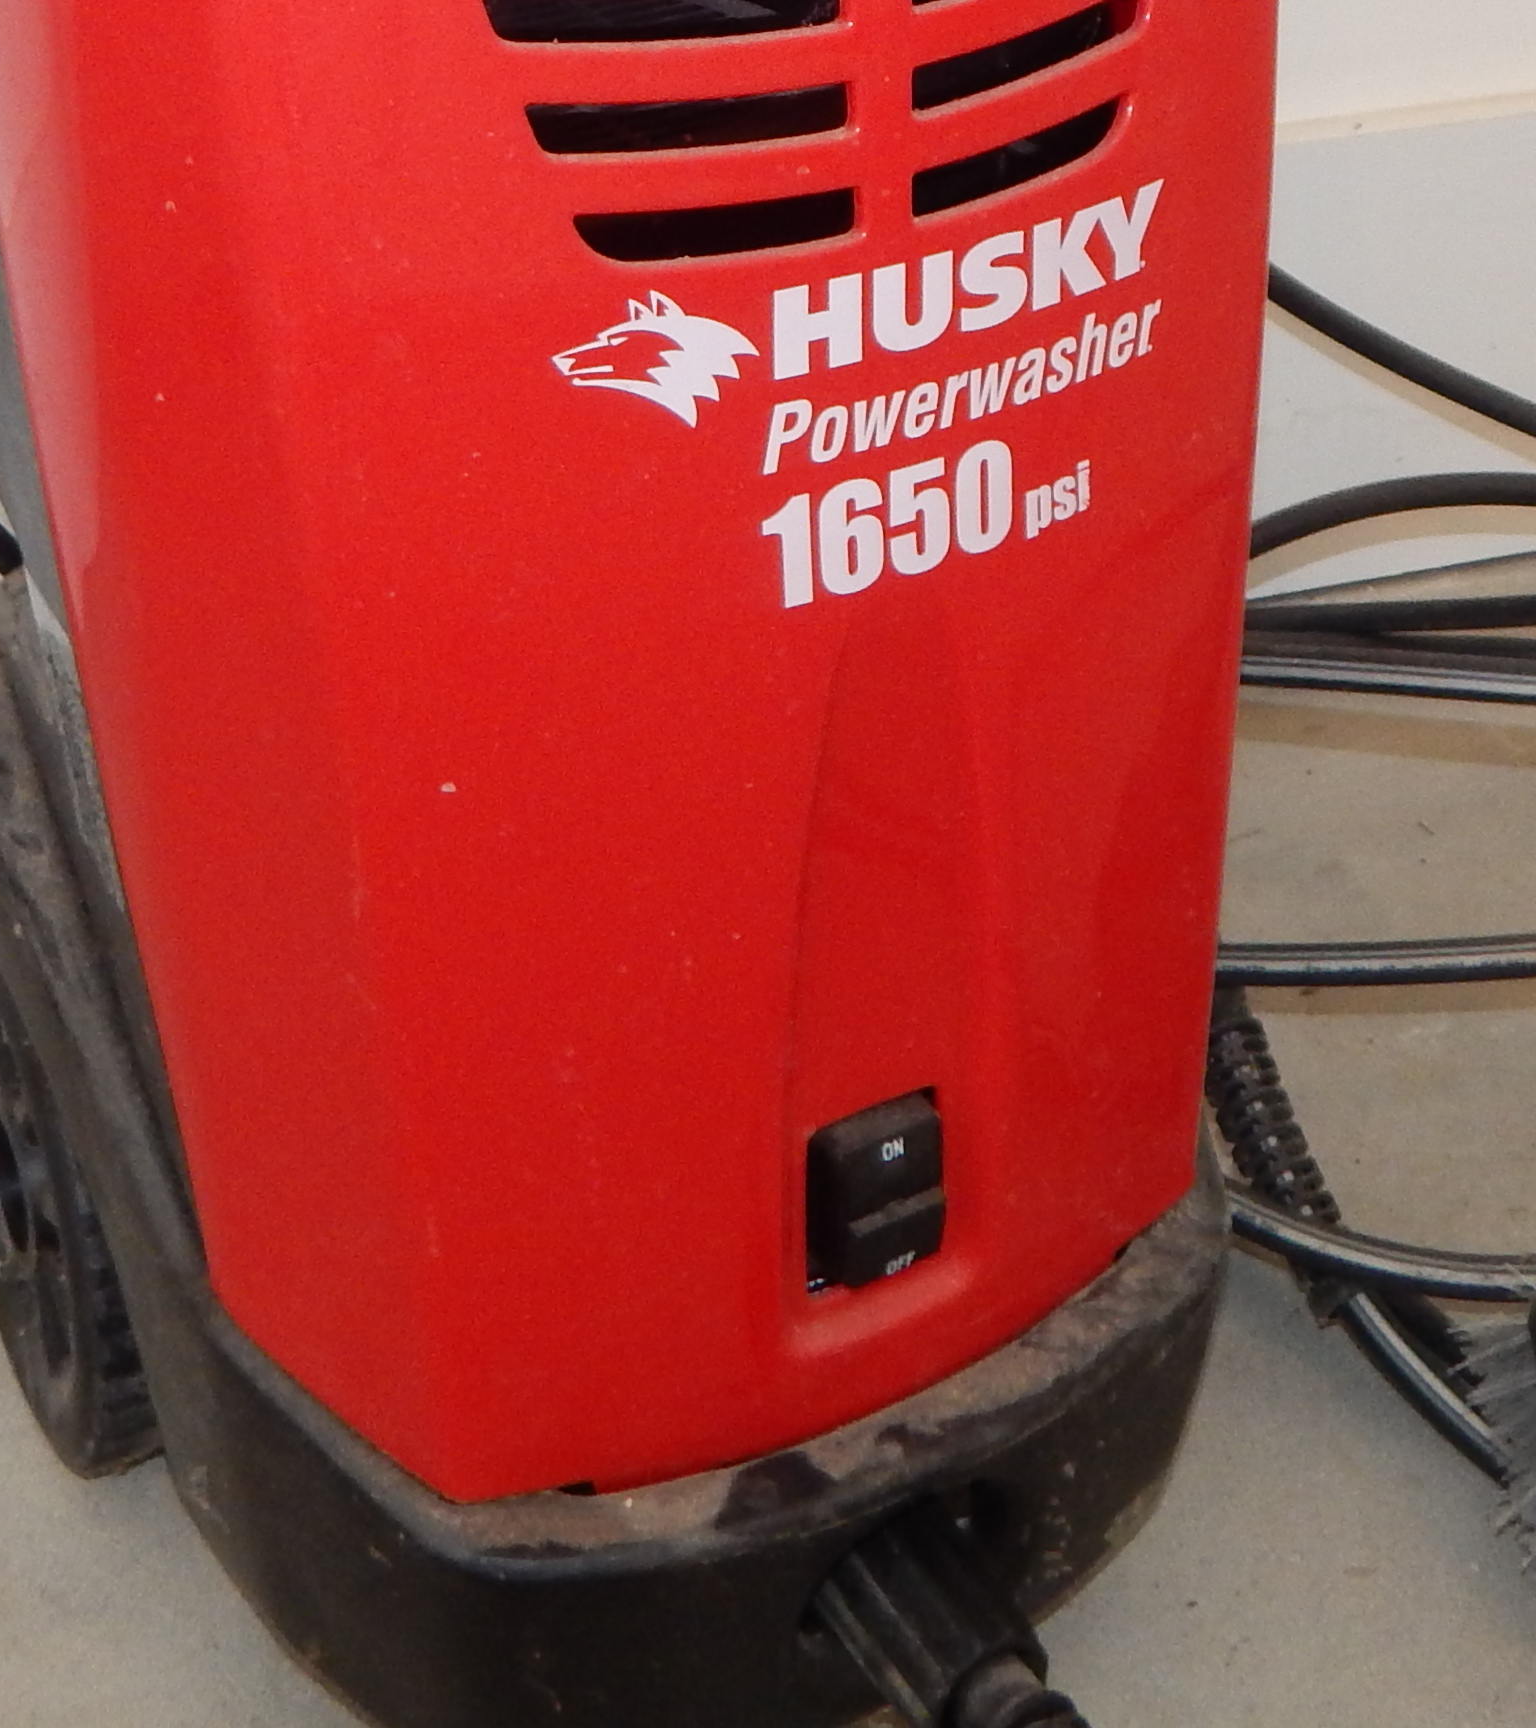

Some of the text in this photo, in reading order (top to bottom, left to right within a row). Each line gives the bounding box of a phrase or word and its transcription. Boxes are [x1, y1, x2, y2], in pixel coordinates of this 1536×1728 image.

[772, 177, 1165, 381] HUSKY
[762, 298, 1163, 476] Powerwasher
[760, 439, 1092, 610] 1650 psi
[881, 1136, 906, 1162] ON
